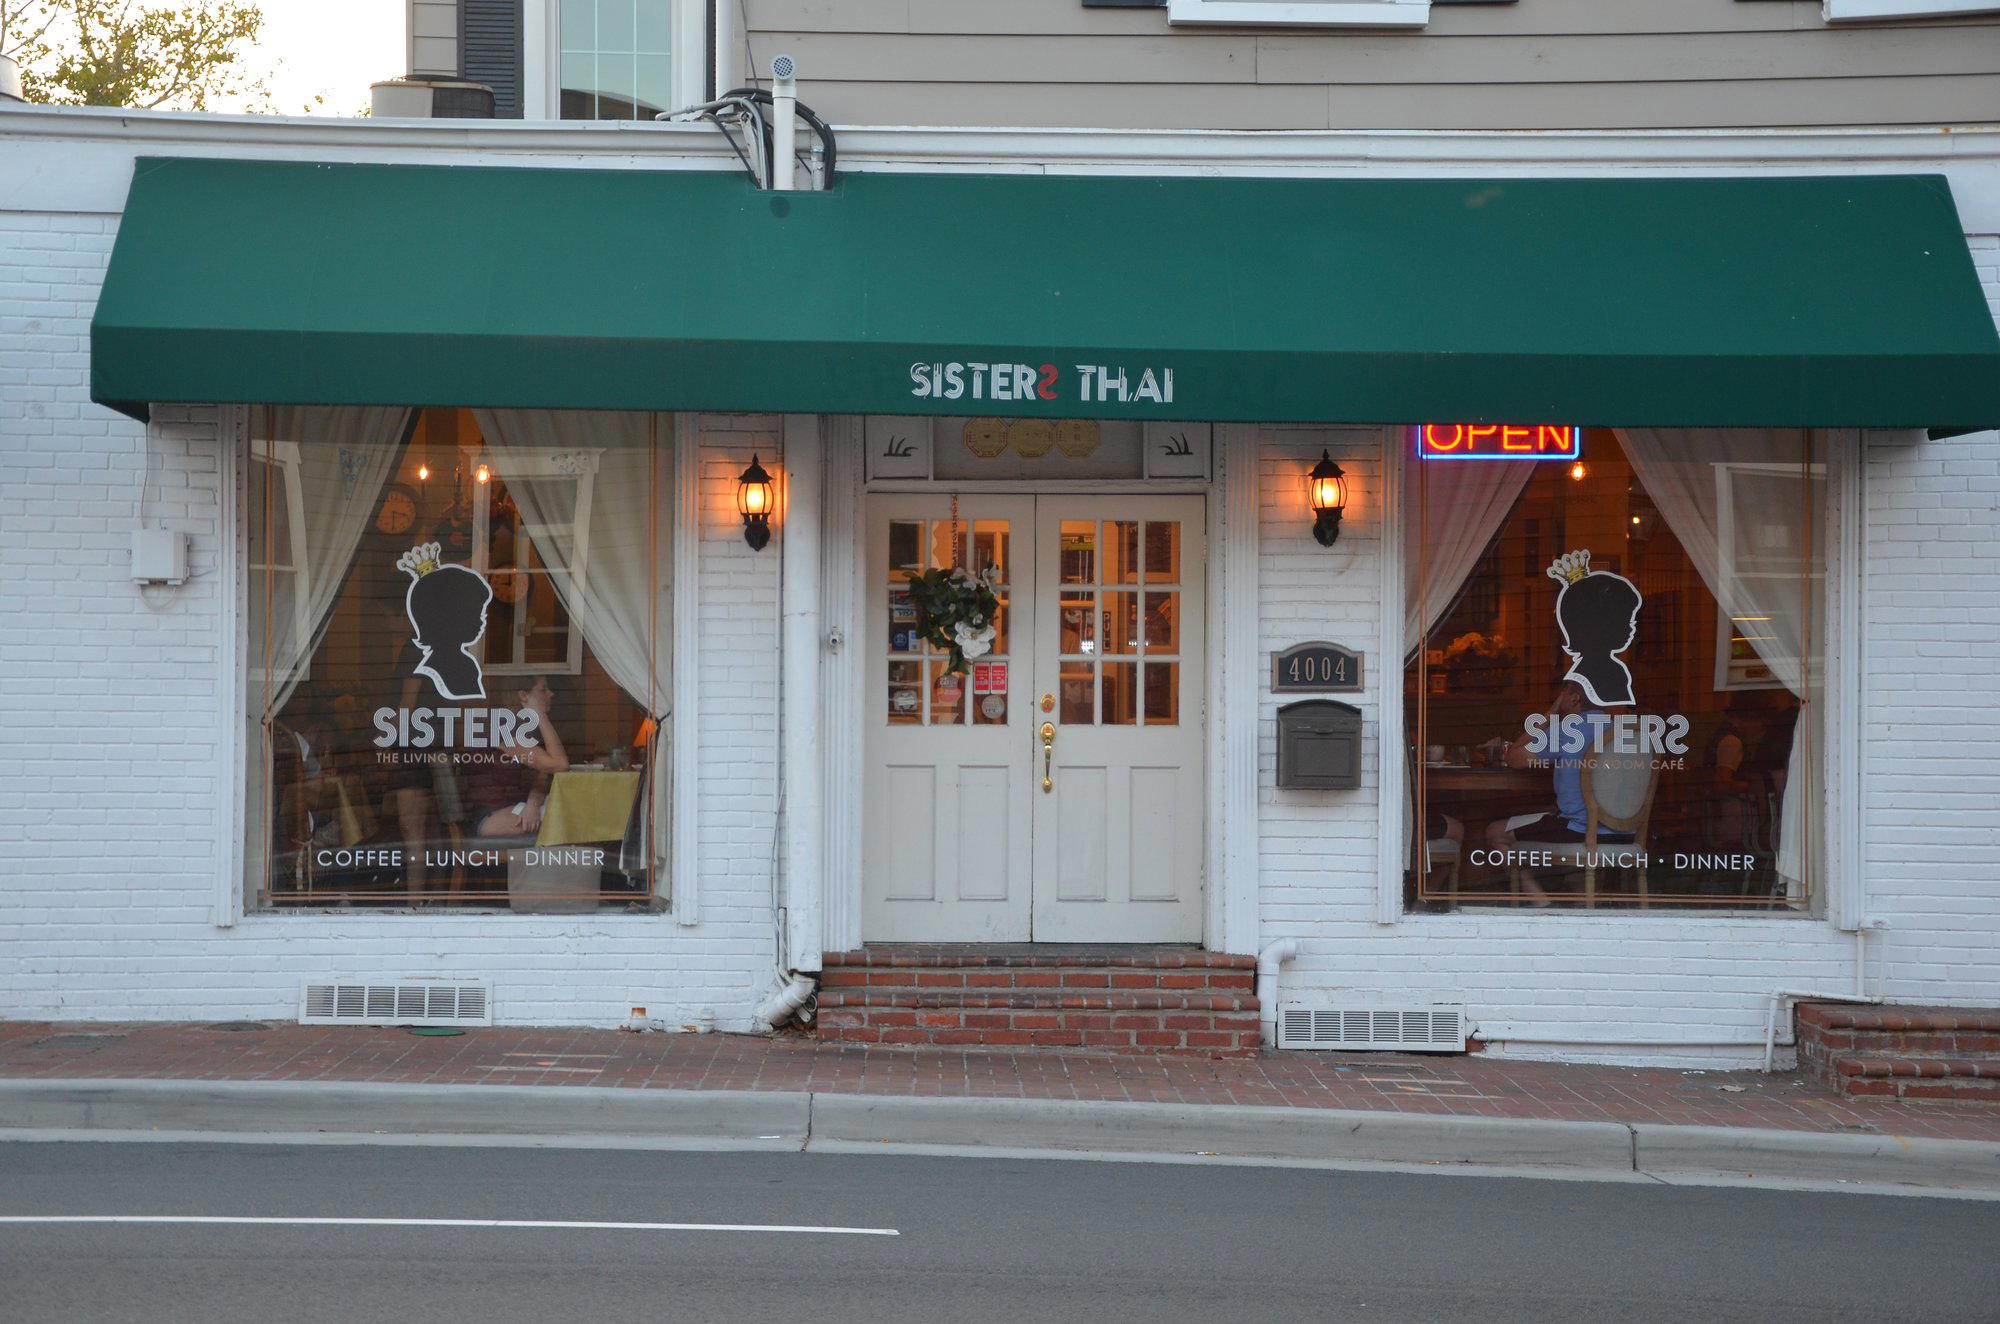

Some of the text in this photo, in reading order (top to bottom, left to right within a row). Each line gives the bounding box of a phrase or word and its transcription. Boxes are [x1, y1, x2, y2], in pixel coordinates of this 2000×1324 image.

[910, 362, 1174, 403] SISTERS THAI
[1426, 424, 1570, 451] OPEN
[1289, 657, 1346, 681] 4004
[372, 706, 540, 749] SISTERS
[1523, 713, 1690, 755] SISTERS
[376, 751, 535, 765] THE LIVING ROOM CAFÉ
[1527, 758, 1550, 769] THE
[1554, 758, 1598, 769] LIVING
[1651, 757, 1685, 770] CAFÉ
[317, 850, 605, 867] COFFEE LUNCH DINNER
[1470, 849, 1754, 871] COFFEE LUNCH DINNER
